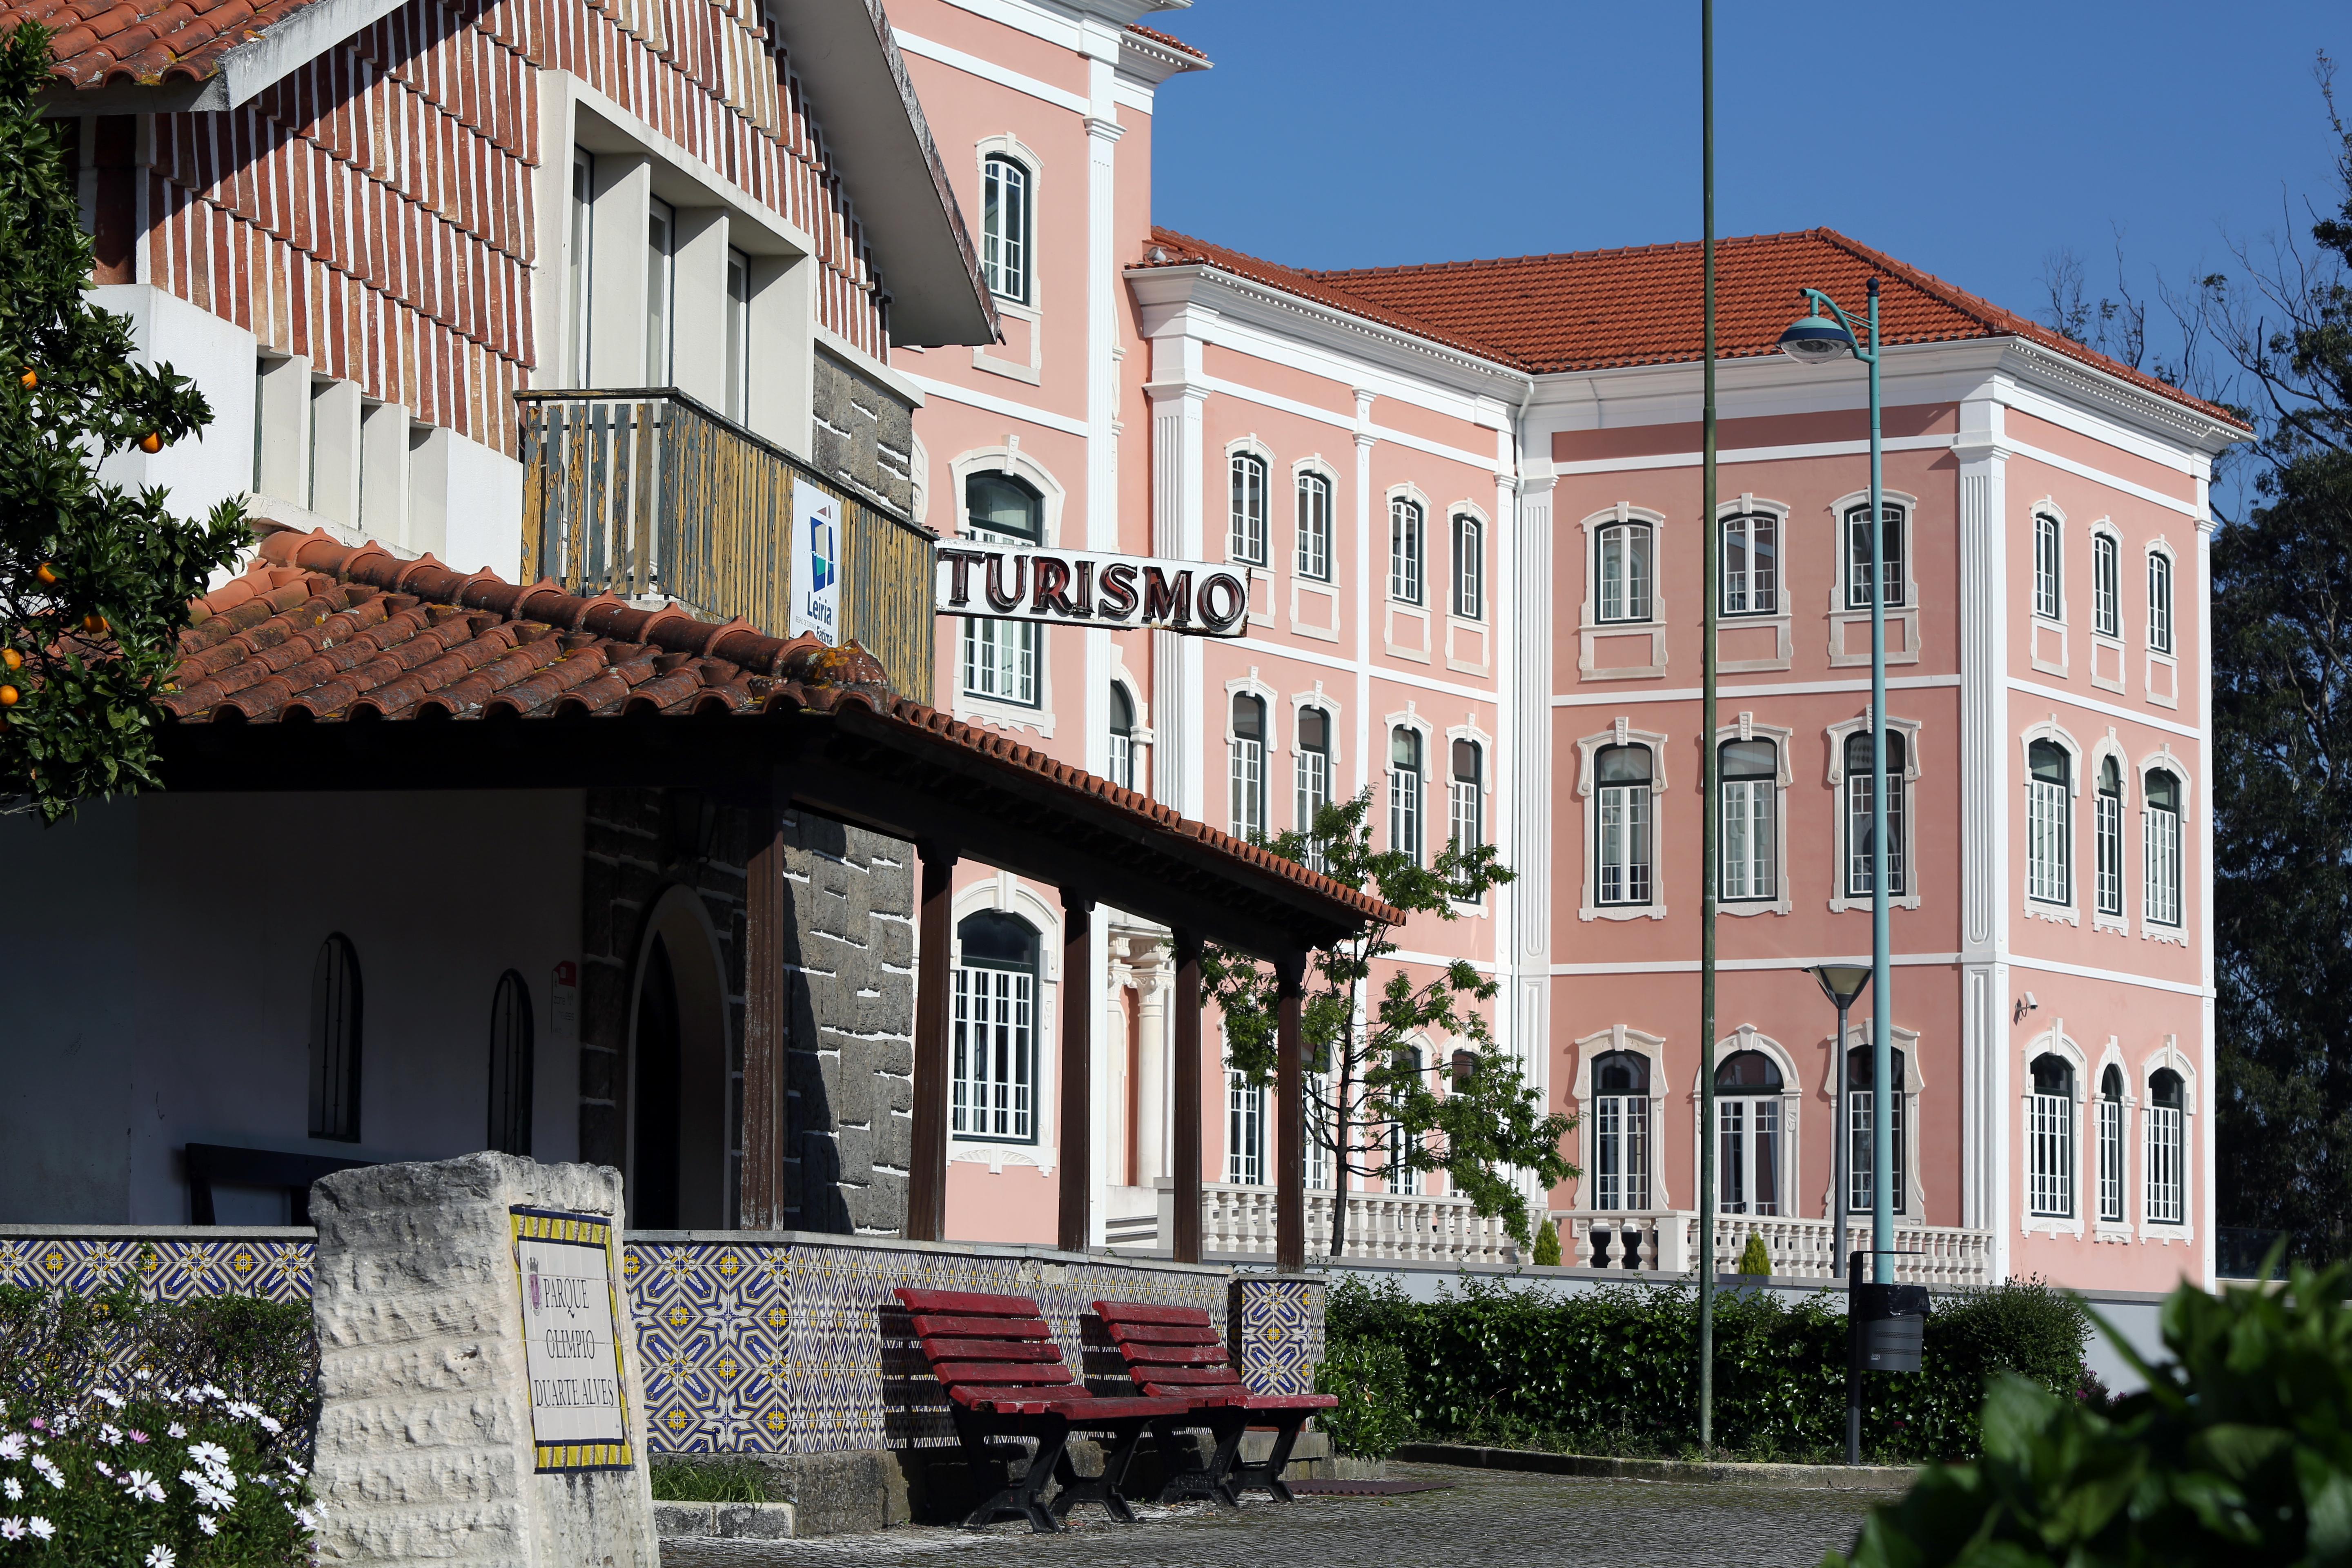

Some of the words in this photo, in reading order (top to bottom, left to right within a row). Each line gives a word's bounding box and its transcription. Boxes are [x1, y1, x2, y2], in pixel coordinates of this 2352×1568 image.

[938, 547, 1245, 631] TURISMO
[807, 591, 831, 626] Leiria
[817, 626, 833, 645] Fátima
[544, 1278, 589, 1318] PARQUE
[546, 1330, 595, 1359] OLIMPIO
[534, 1379, 579, 1407] DUARTE
[581, 1379, 614, 1407] ALVES
